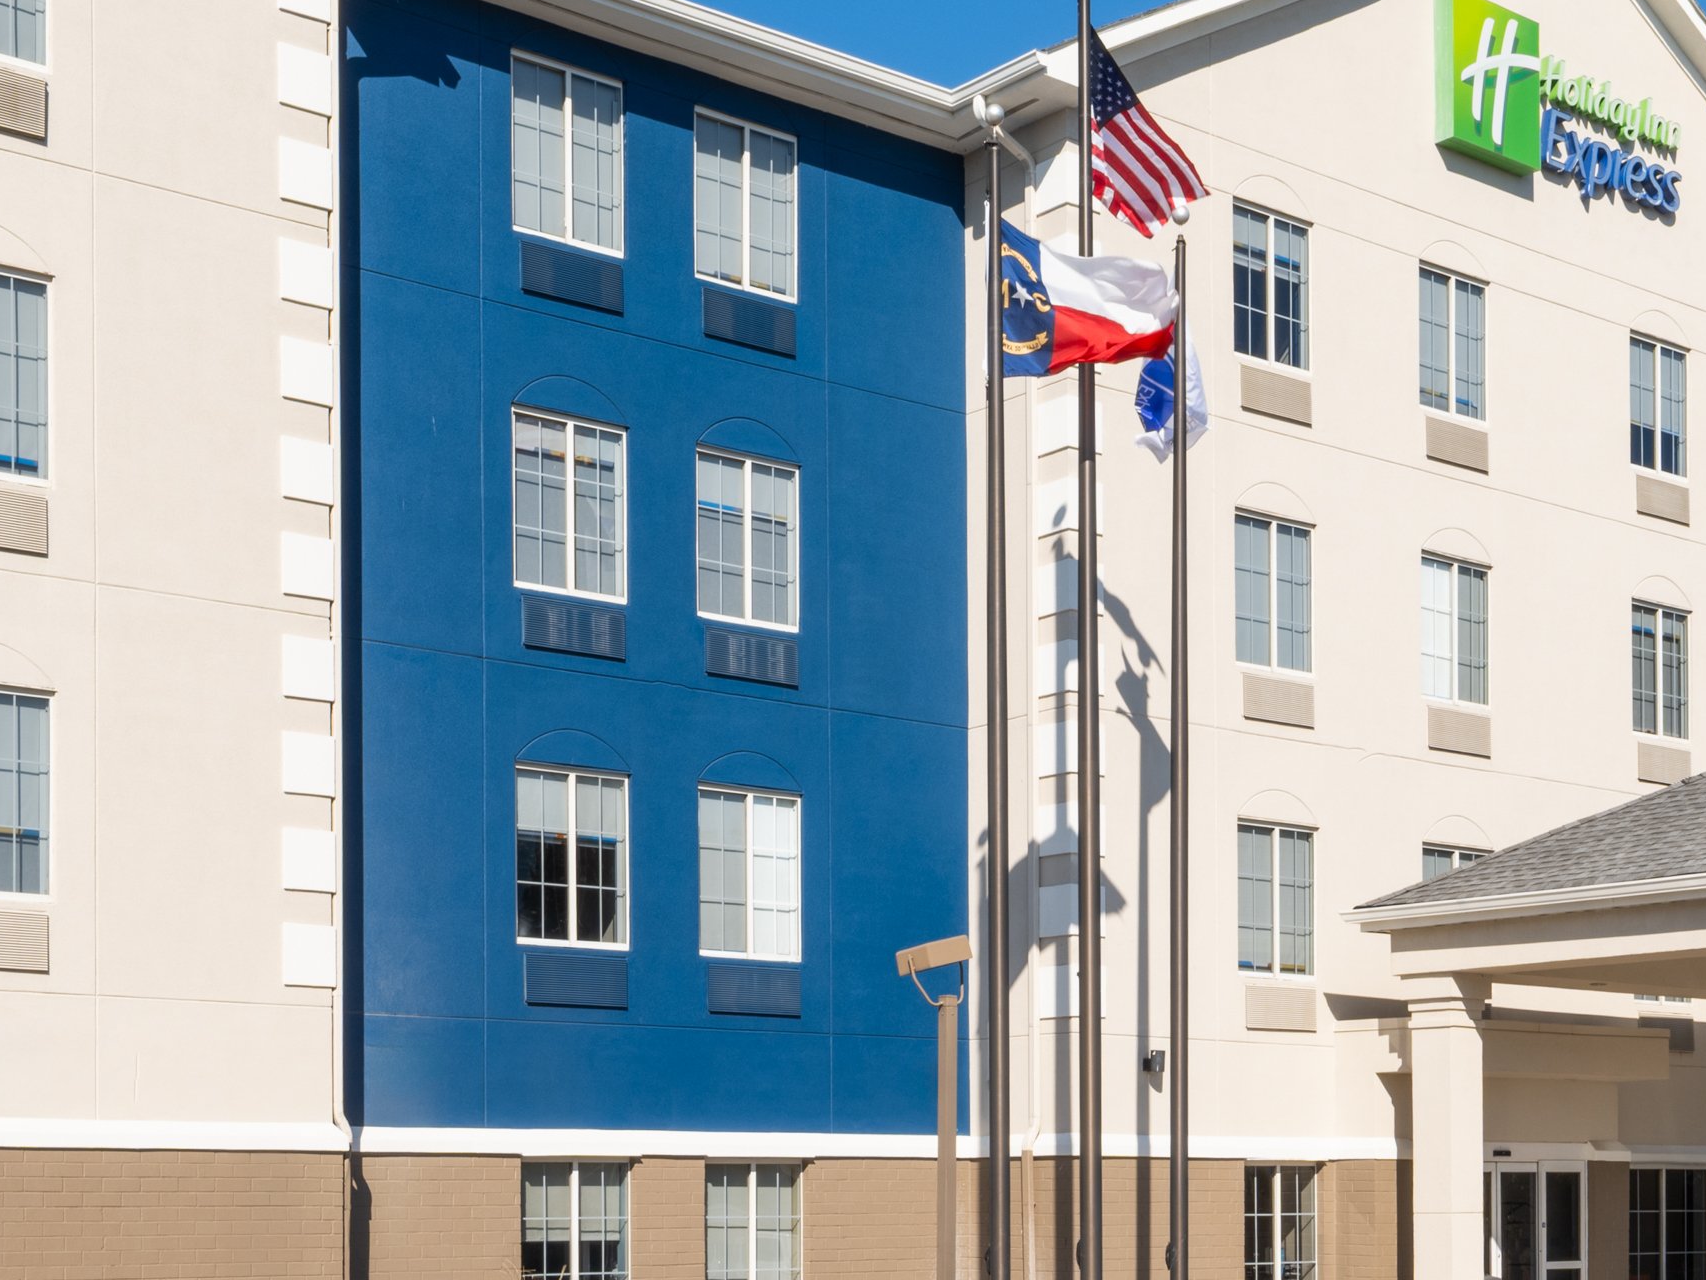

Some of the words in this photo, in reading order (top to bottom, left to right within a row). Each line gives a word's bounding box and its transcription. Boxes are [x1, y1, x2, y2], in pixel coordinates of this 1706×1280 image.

[1461, 17, 1540, 146] H
[1540, 54, 1642, 141] Holiday
[1640, 97, 1682, 150] Inn
[1541, 108, 1682, 214] Express
